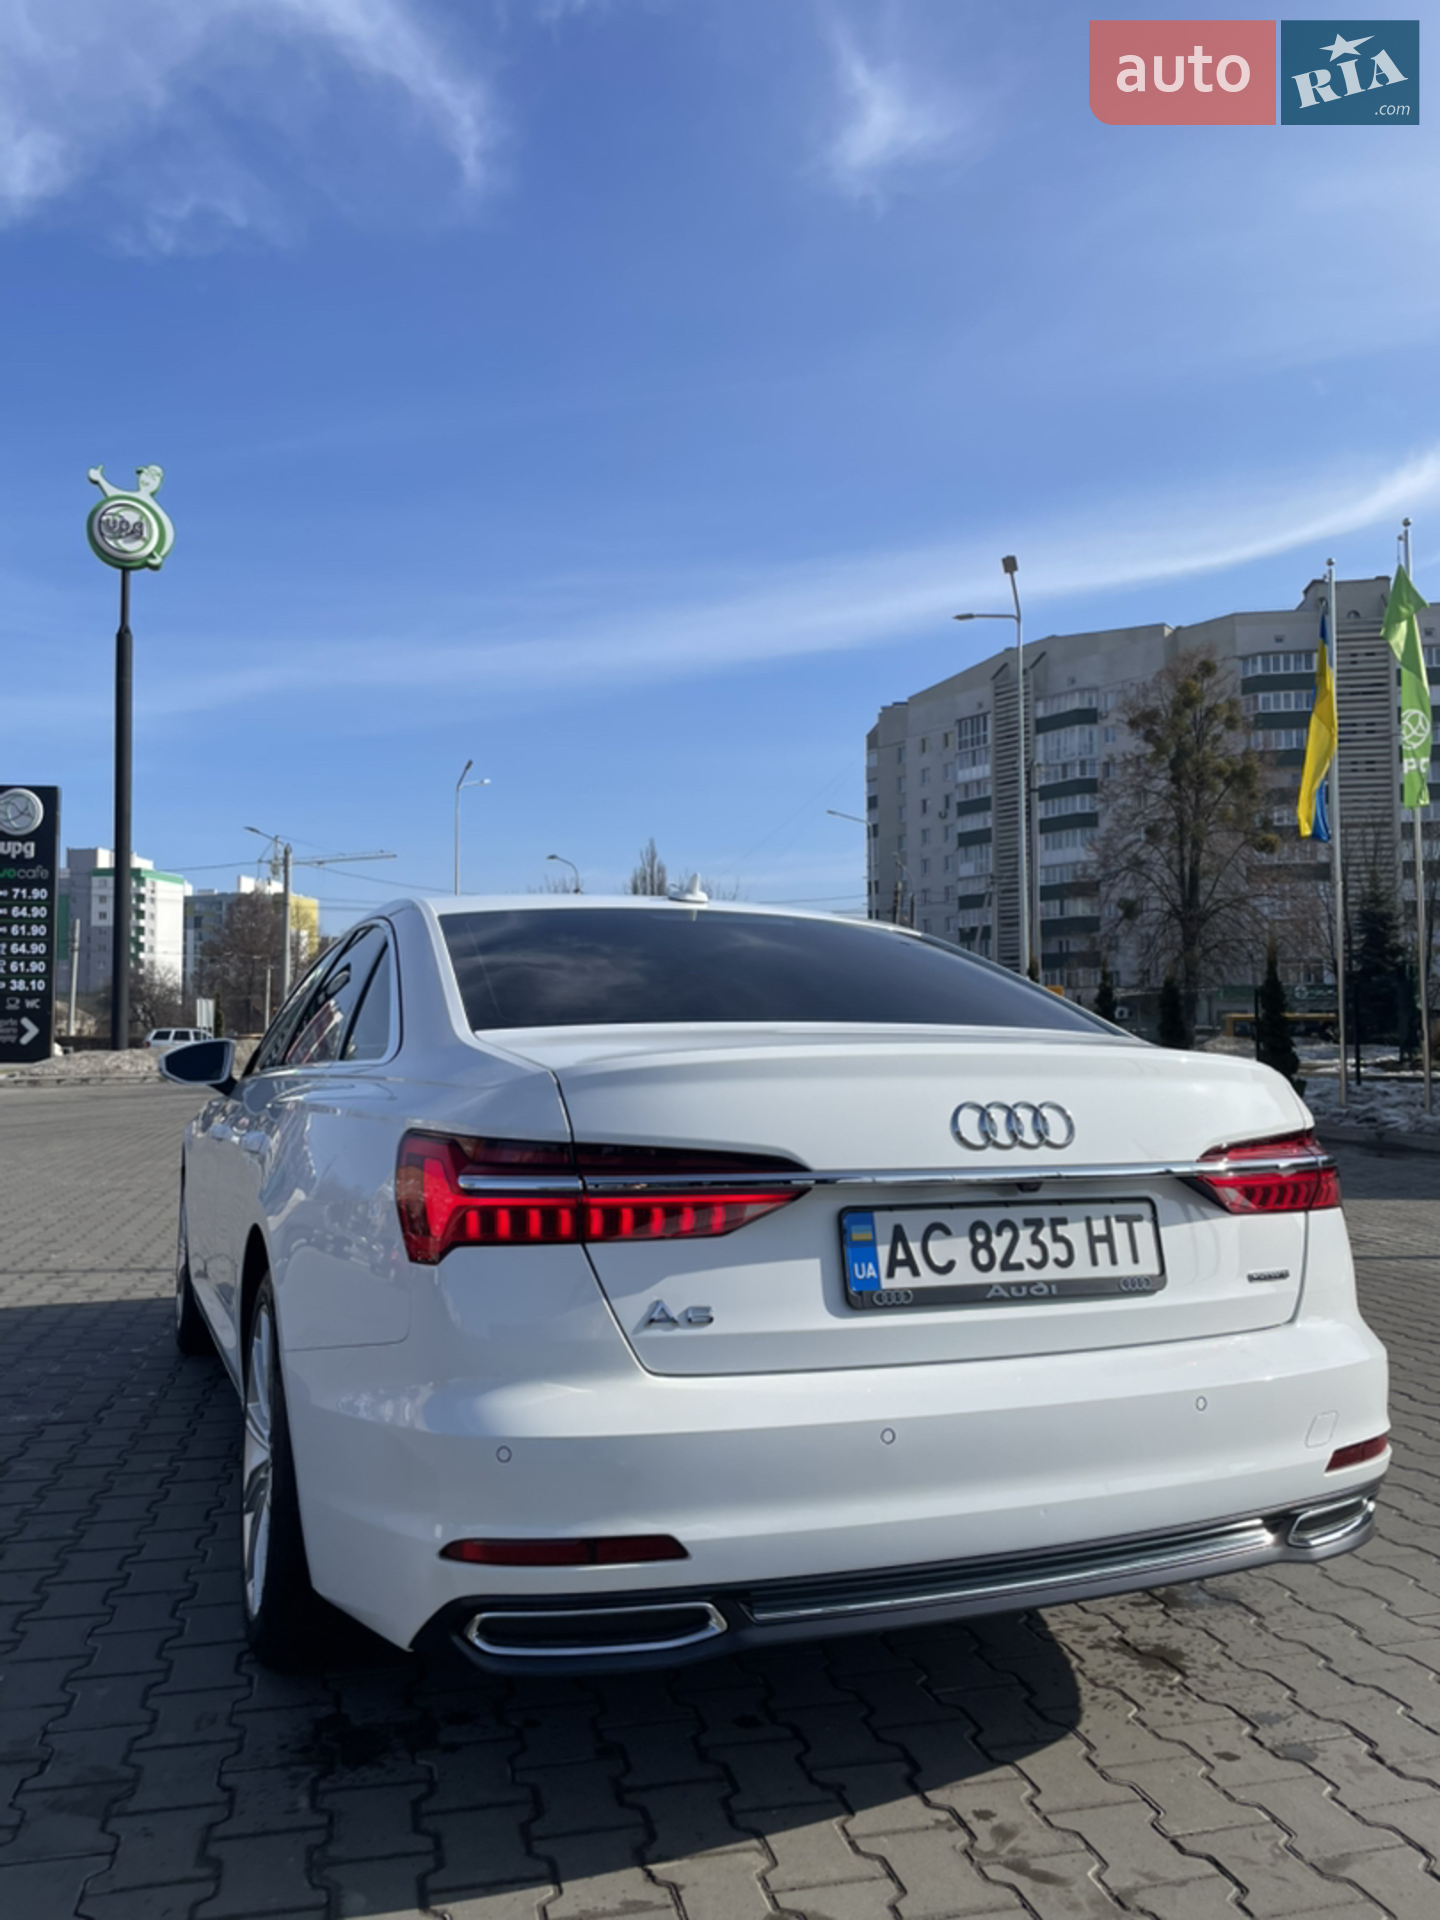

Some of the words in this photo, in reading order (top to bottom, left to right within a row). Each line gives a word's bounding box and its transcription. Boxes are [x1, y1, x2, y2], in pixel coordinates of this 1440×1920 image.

[12, 888, 48, 900] 71.90
[11, 906, 48, 918] 64.90
[10, 924, 47, 936] 61.90
[10, 943, 47, 955] 64.90
[9, 961, 46, 973] 61.90
[9, 979, 46, 991] 38.10
[886, 1221, 957, 1279] AC
[968, 1216, 1075, 1273] 8235
[1084, 1213, 1144, 1267] HT
[853, 1262, 878, 1280] UA
[986, 1281, 1059, 1299] Audi
[642, 1299, 715, 1328] A6
